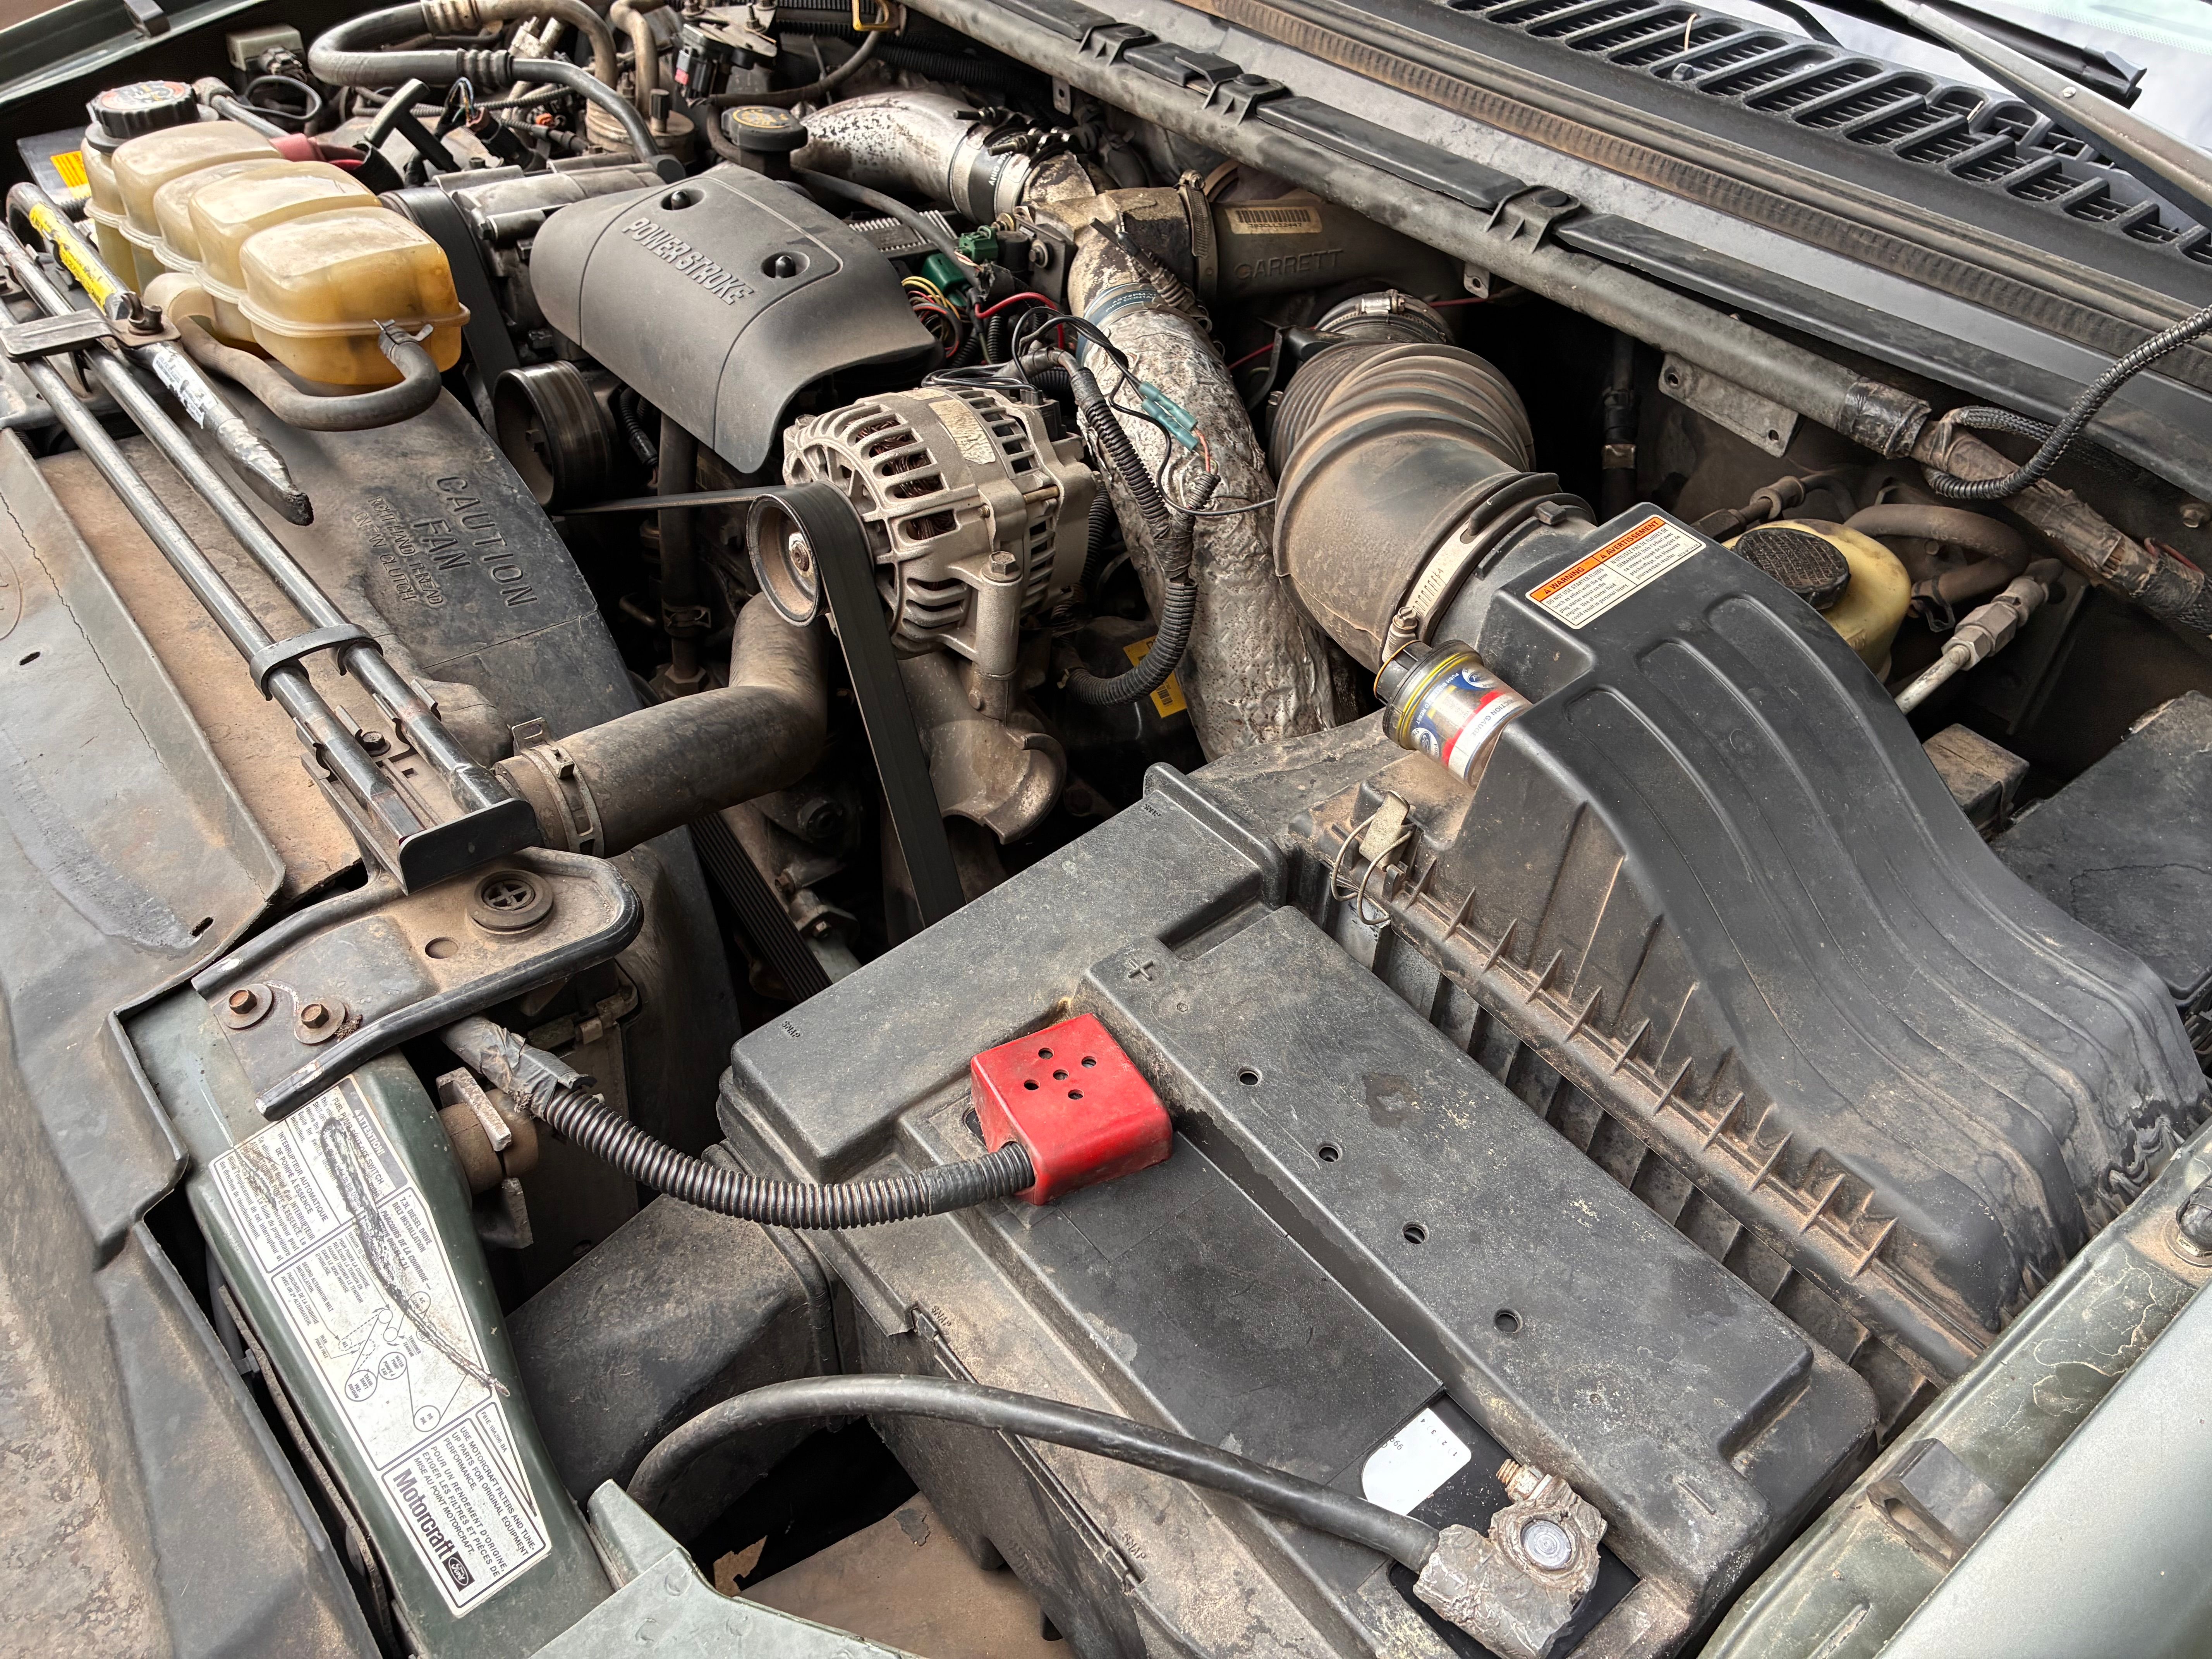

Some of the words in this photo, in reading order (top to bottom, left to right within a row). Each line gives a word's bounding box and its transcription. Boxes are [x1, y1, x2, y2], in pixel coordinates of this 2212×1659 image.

[622, 218, 688, 264] POWER
[680, 251, 756, 306] STROKE
[1234, 249, 1344, 279] GARRETT
[414, 520, 471, 570] FAN
[436, 476, 538, 608] CAUTION
[1606, 520, 1659, 555] AVERTISSEMENT
[1549, 567, 1585, 589] WARNING
[1492, 699, 1515, 719] RICTION
[332, 1097, 343, 1113] FUEL
[364, 1159, 384, 1185] SWITCH
[356, 1115, 385, 1156] ATTENTION!
[275, 1147, 283, 1157] DE
[279, 1156, 294, 1179] POMPE
[294, 1183, 313, 1214] ESSENCE
[277, 1131, 303, 1176] INTERRUPTEUR
[299, 1176, 328, 1222] AUTOMATIQUE
[289, 1201, 315, 1240] INTERRUPTEUR
[380, 1210, 401, 1238] PARCOURS
[397, 1238, 407, 1247] DE
[402, 1247, 411, 1255] LA
[408, 1255, 428, 1282] COURROIE
[392, 1202, 404, 1215] BELT
[400, 1215, 426, 1252] INSTALLATION
[400, 1197, 410, 1209] 7.3L
[407, 1209, 421, 1229] DIESEL
[418, 1228, 432, 1245] DRIVE
[443, 1437, 476, 1491] PERFORMANCE.
[452, 1432, 461, 1441] UP
[458, 1443, 474, 1466] PARTS
[472, 1467, 484, 1482] FOR
[482, 1482, 503, 1516] ORIGINAL
[501, 1516, 528, 1556] EQUIPMENT
[460, 1426, 472, 1441] USE
[468, 1441, 499, 1486] MOTORCRAFT
[495, 1487, 514, 1514] FILTERS
[511, 1515, 523, 1528] AND
[393, 1468, 455, 1559] Motorcraft
[414, 1457, 428, 1475] MISE
[424, 1475, 434, 1485] AU
[430, 1485, 447, 1505] POINT
[443, 1506, 474, 1554] MOTORCRAFT.
[422, 1451, 441, 1479] EXIGER
[439, 1480, 451, 1494] LES
[448, 1495, 469, 1525] FILTRES
[466, 1526, 476, 1535] ET
[473, 1537, 492, 1565] PIÈCES
[489, 1566, 500, 1577] DE
[430, 1446, 447, 1468] POUR
[444, 1468, 455, 1480] UN
[451, 1482, 483, 1527] RENDEMENT
[480, 1529, 507, 1571] D'ORIGINE,
[450, 1561, 467, 1582] Ford
